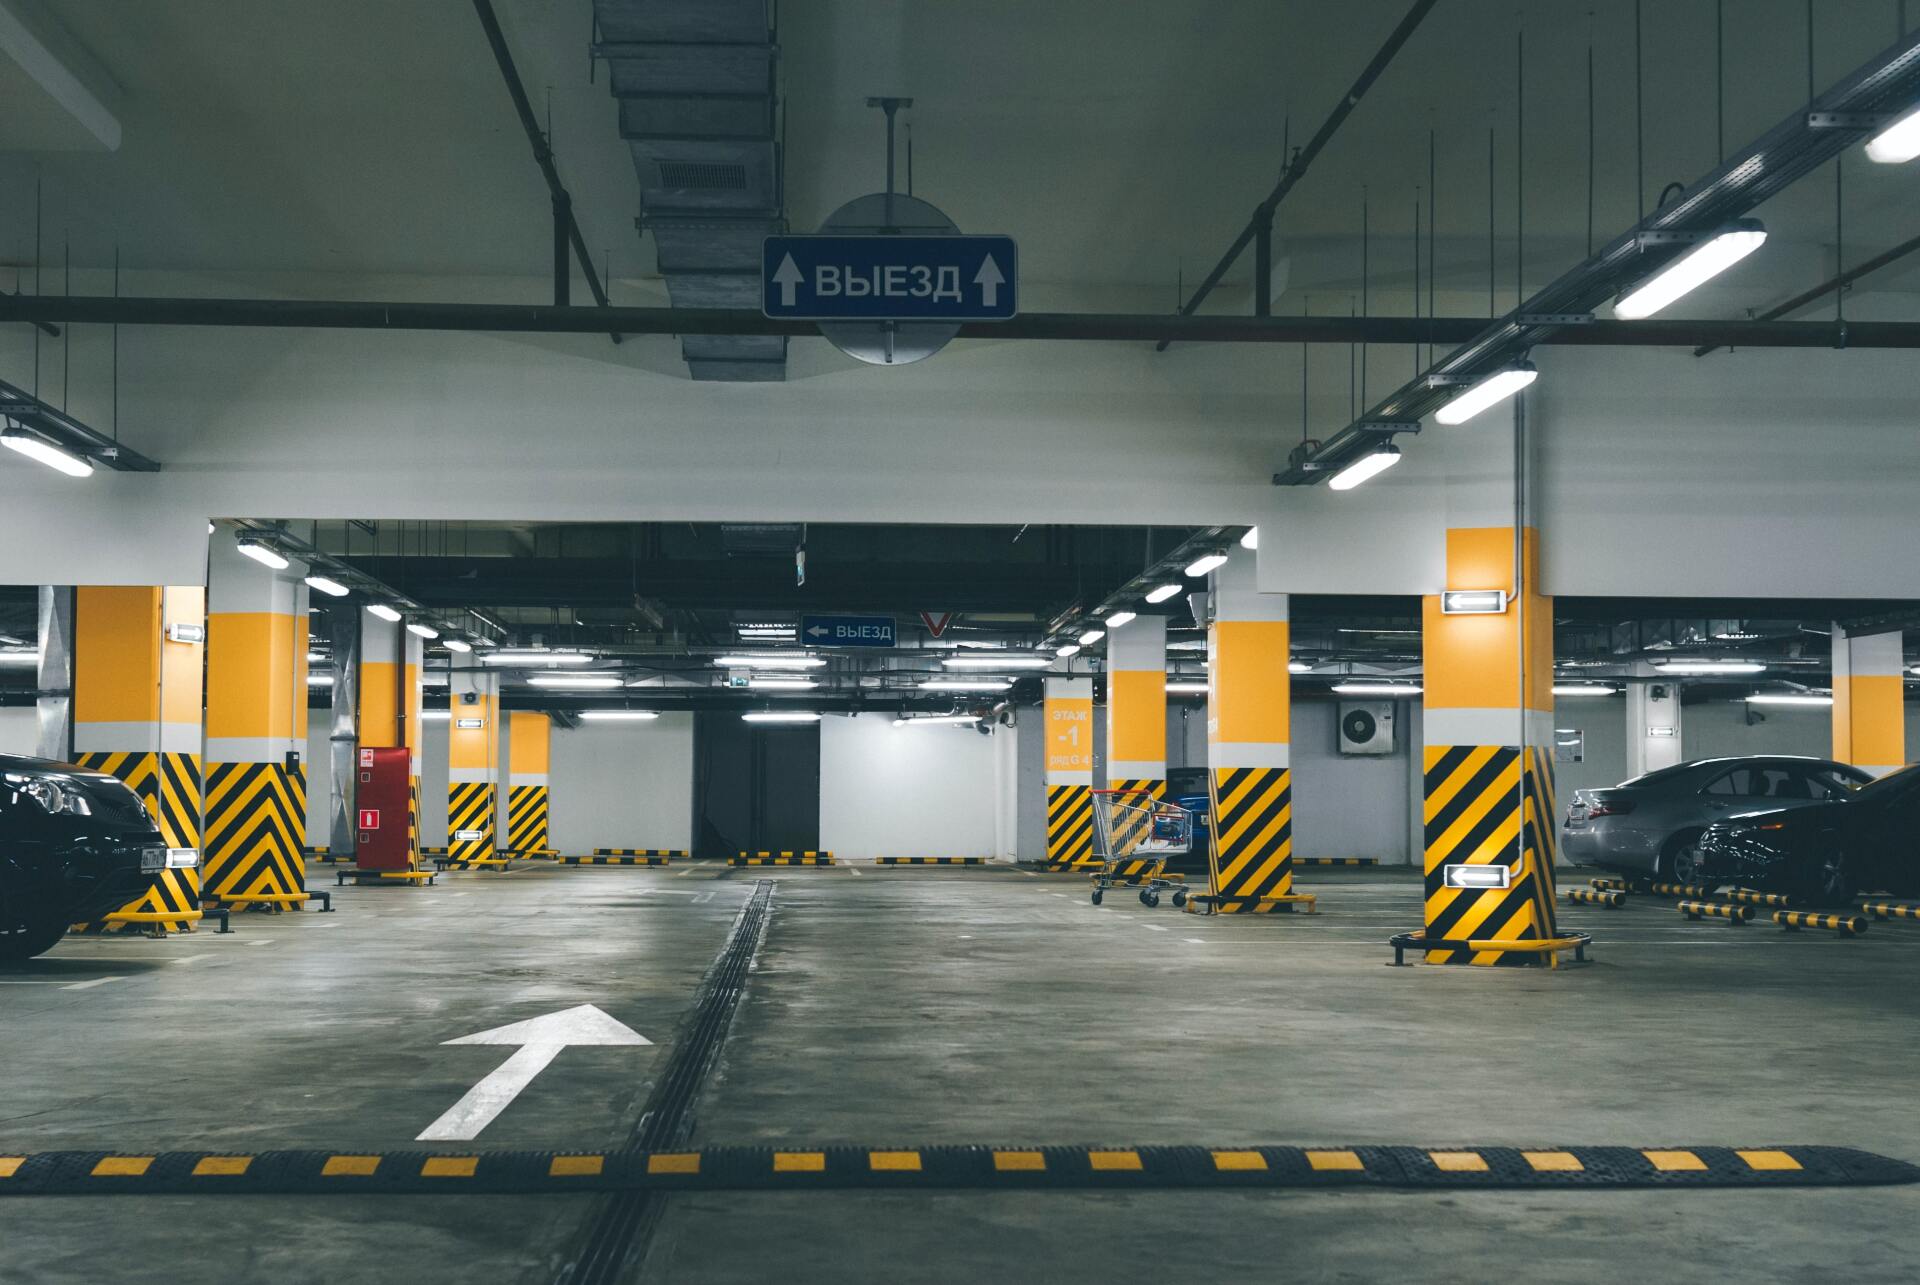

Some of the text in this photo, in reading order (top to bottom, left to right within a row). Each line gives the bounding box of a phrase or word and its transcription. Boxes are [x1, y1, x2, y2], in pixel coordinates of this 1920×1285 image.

[815, 265, 963, 303] ВЫЕЗД
[836, 625, 892, 641] ВЫЕЗД
[1053, 710, 1087, 721] ЭТАЖ
[1058, 725, 1079, 747] -1
